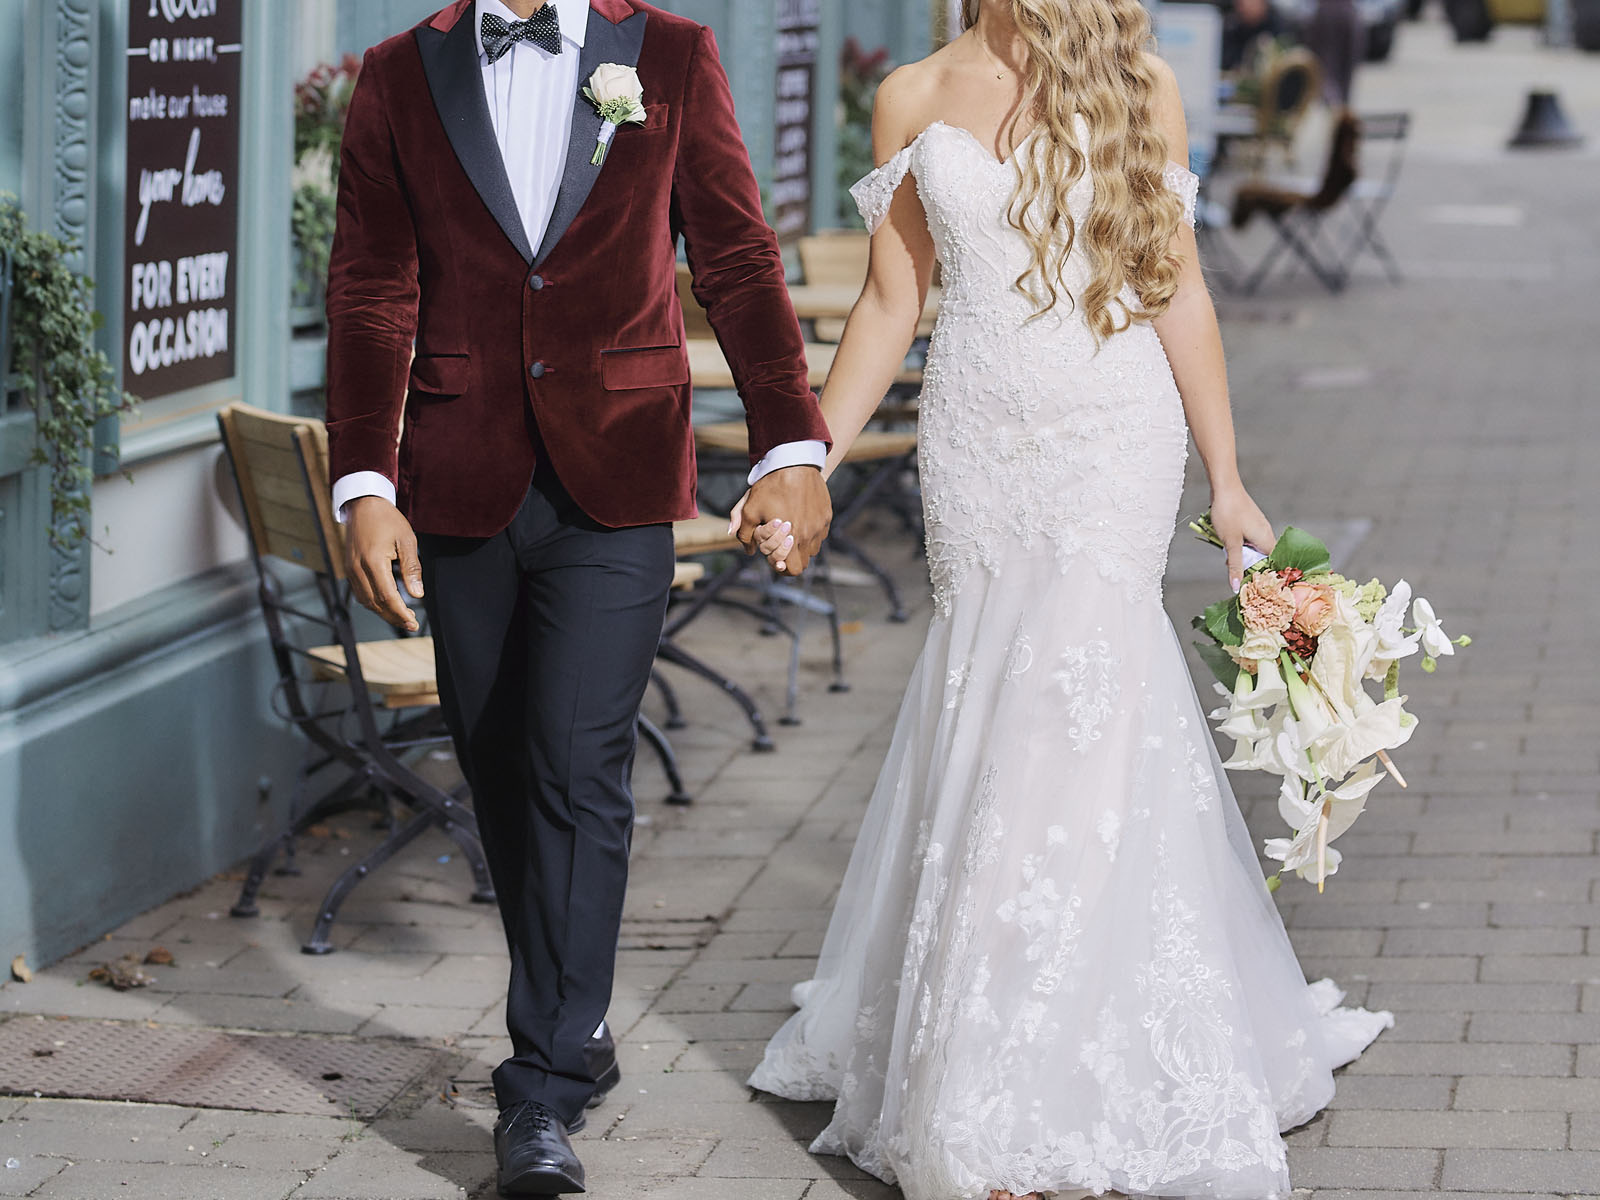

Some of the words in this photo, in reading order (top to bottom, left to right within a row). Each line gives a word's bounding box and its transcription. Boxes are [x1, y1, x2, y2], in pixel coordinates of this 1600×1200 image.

[130, 87, 166, 121] make
[168, 95, 191, 119] our
[193, 84, 228, 117] house
[135, 168, 182, 246] your
[131, 260, 172, 312] FOR
[177, 251, 229, 304] EVERY
[129, 307, 228, 375] OCCASION
